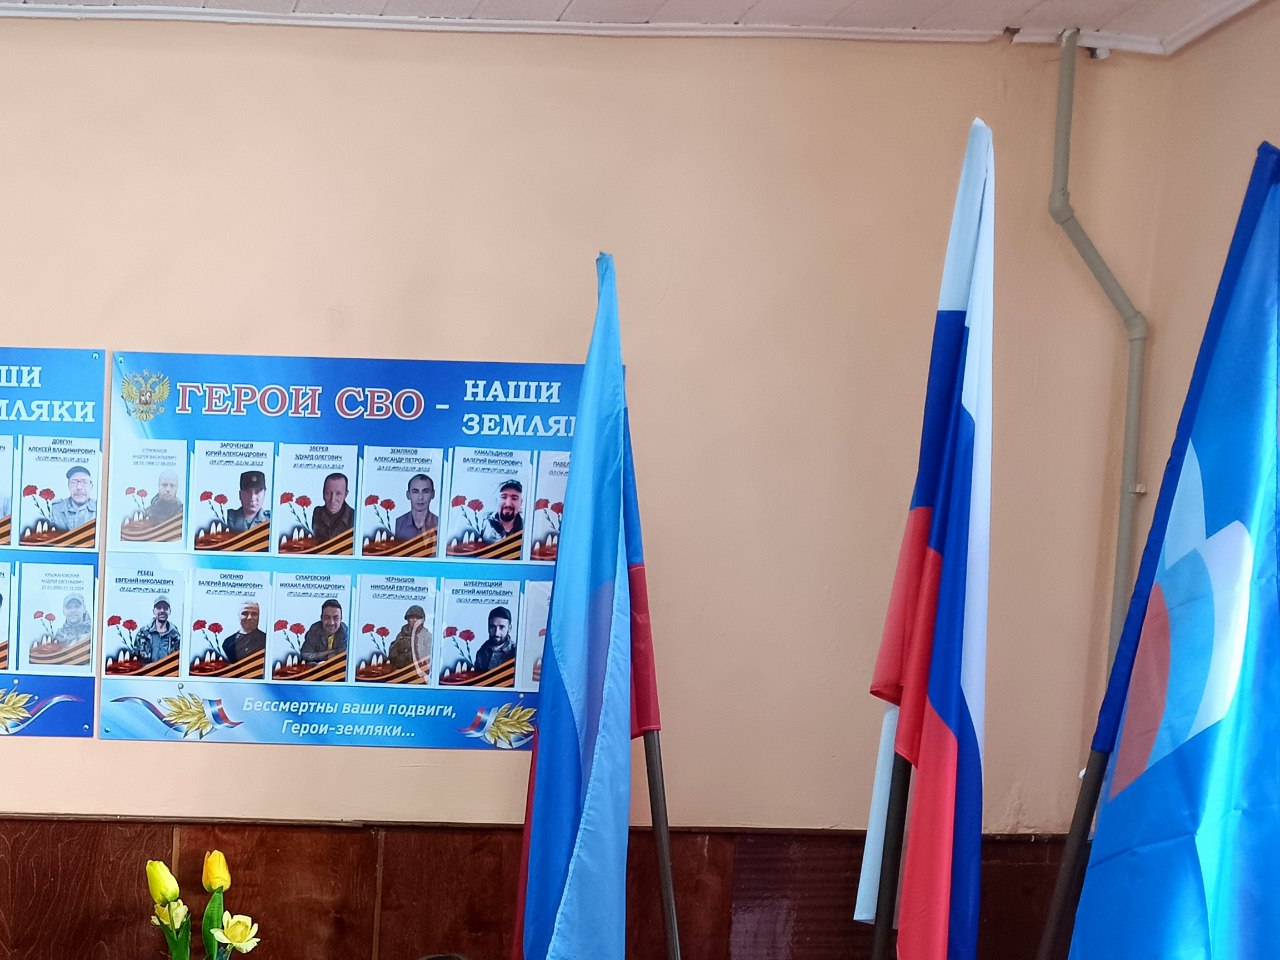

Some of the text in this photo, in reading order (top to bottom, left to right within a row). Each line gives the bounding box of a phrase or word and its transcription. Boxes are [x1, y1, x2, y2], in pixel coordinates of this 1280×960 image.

[176, 381, 322, 418] ГЕРОИ
[335, 386, 425, 421] СВО
[464, 379, 561, 403] НАШИ
[462, 413, 576, 437] ЗЕМЛЯ
[243, 697, 456, 719] Бессмертны ваши подвиги,
[282, 720, 415, 737] Герои-земляки...
